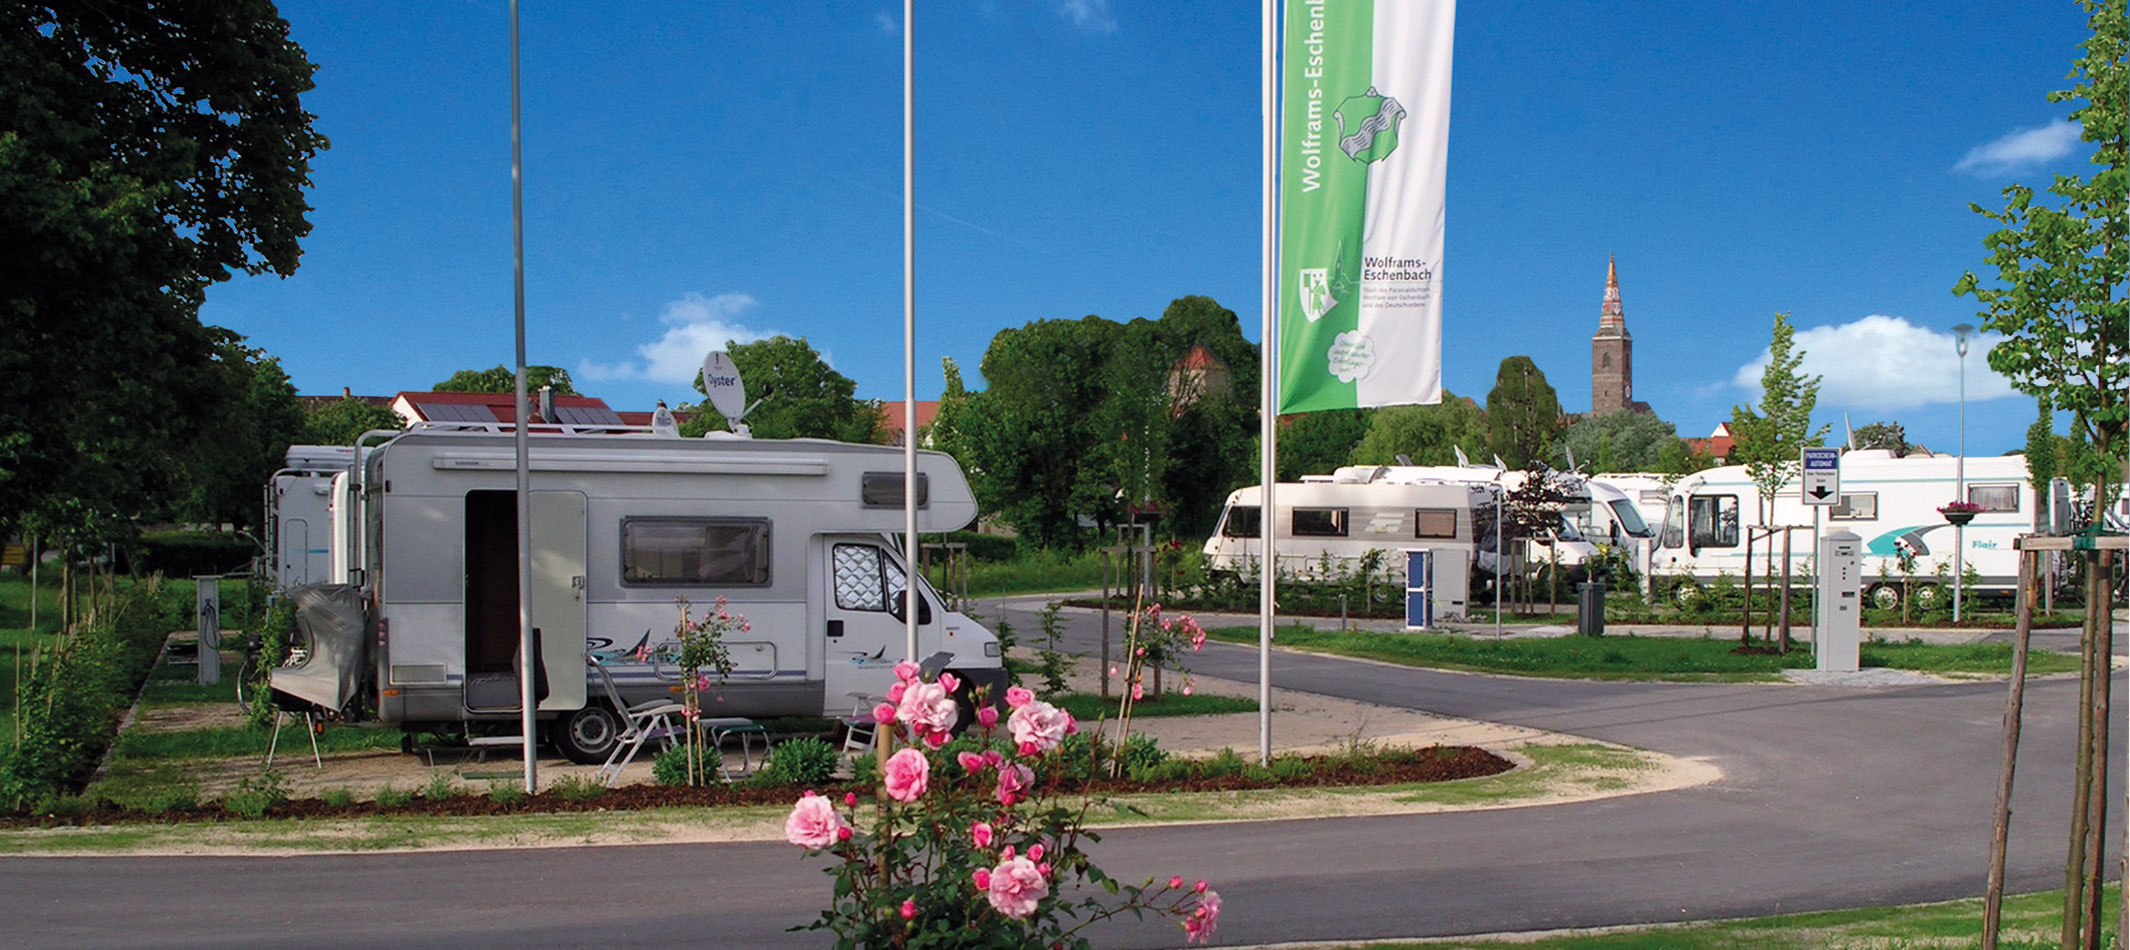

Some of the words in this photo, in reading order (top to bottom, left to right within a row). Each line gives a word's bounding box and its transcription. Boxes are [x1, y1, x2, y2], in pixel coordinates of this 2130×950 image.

[1364, 256, 1426, 268] Wolframs-
[1364, 268, 1432, 281] Eschenbach
[708, 373, 736, 388] Oyster
[1972, 540, 1998, 549] Flair
